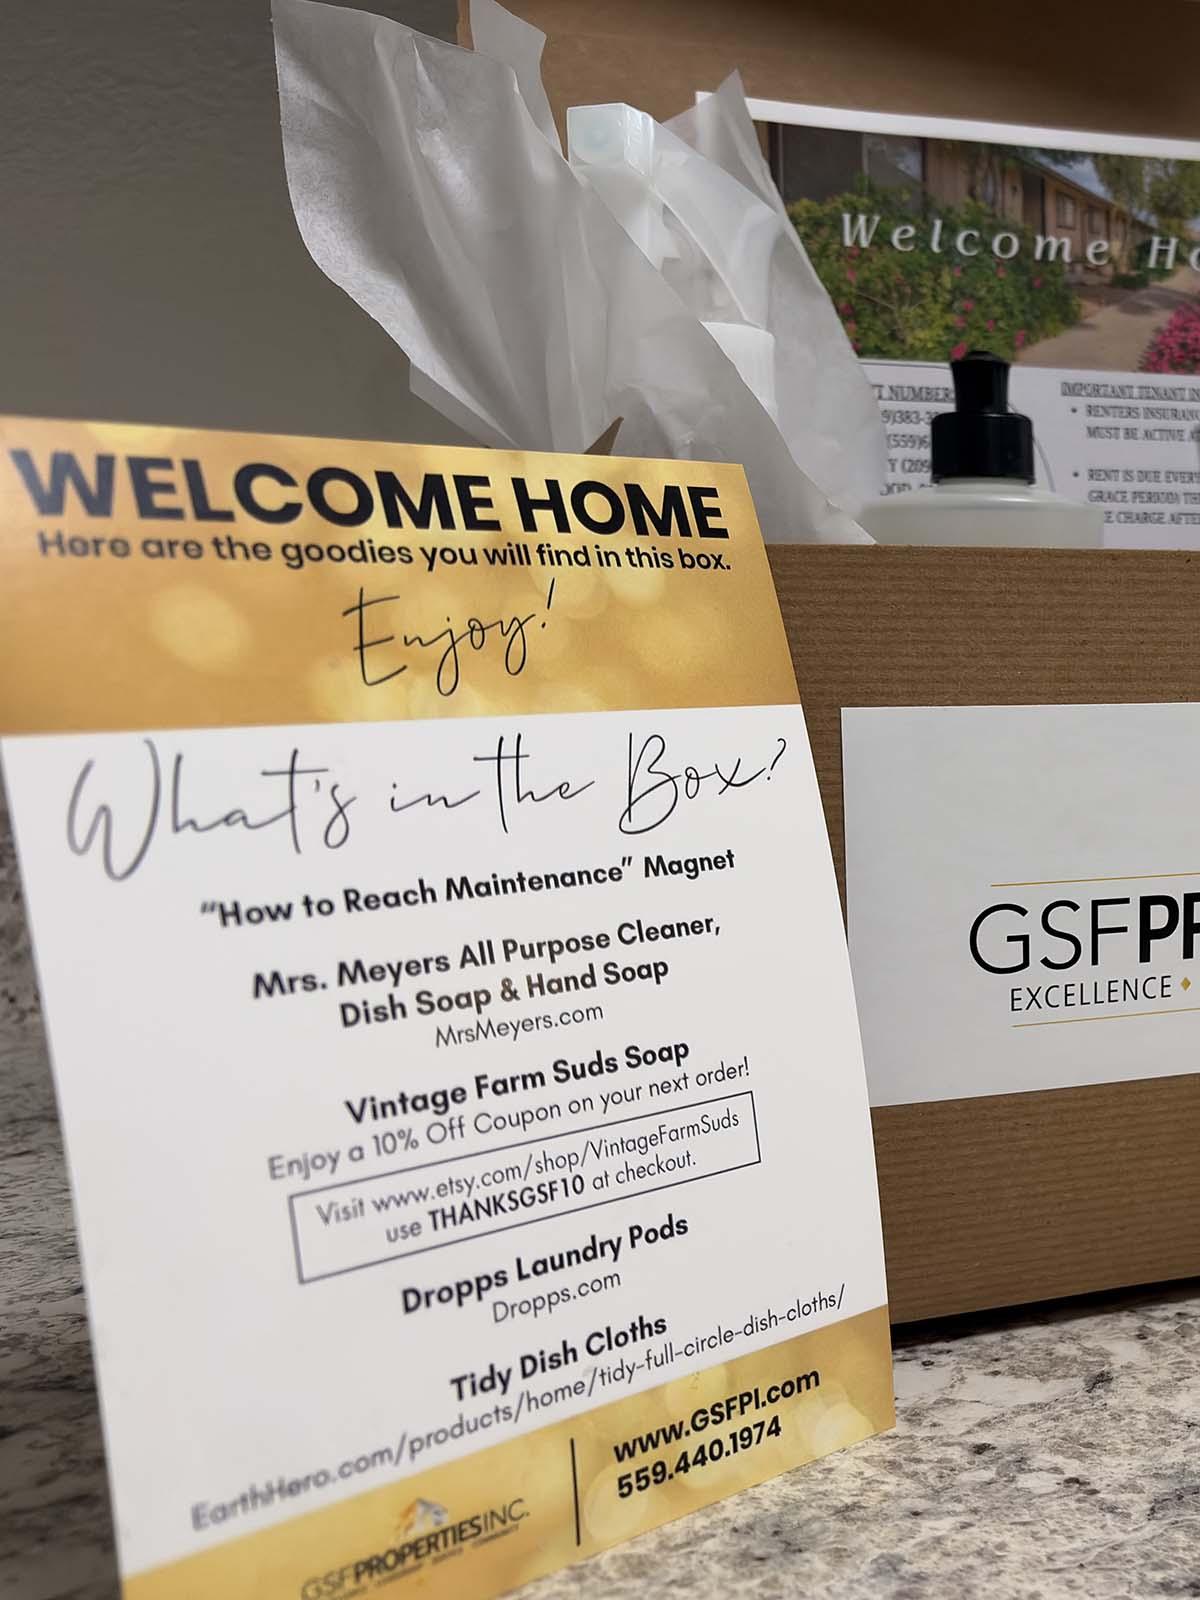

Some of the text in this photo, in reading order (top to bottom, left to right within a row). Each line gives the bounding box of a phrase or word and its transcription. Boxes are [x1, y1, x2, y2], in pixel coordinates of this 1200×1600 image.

[841, 213, 1111, 268] Welcome
[10, 449, 729, 539] WELCOME HOME
[38, 530, 731, 571] Here are the goodies you will find in this box.
[343, 578, 555, 696] Enjoy!
[67, 733, 785, 881] What's in the Box?
[303, 894, 334, 918] to
[344, 880, 437, 913] Reach
[644, 850, 735, 880] Magnet
[254, 914, 721, 999] Mrs. Meyers All Purpose Cleaner,
[340, 958, 670, 1028] Dish Soap & Hand Soap
[1010, 975, 1172, 1012] EXCELLENCE
[436, 1005, 604, 1048] MrsMeyers.com
[267, 1056, 751, 1182] Enjoy a 10% Off Coupon on your next order!
[345, 1041, 690, 1125] Vintage Farm Suds Soap
[315, 1197, 366, 1227] Visit
[386, 1149, 698, 1244] use THANKSGSF10 at checkout.
[401, 1214, 689, 1316] Dropps Laundry Pods
[493, 1270, 621, 1324] Dropps.com
[450, 1313, 668, 1403] Tidy Dish Cloths
[612, 1367, 821, 1464] www.GSFPI.com
[616, 1415, 783, 1500] 559.440.1974
